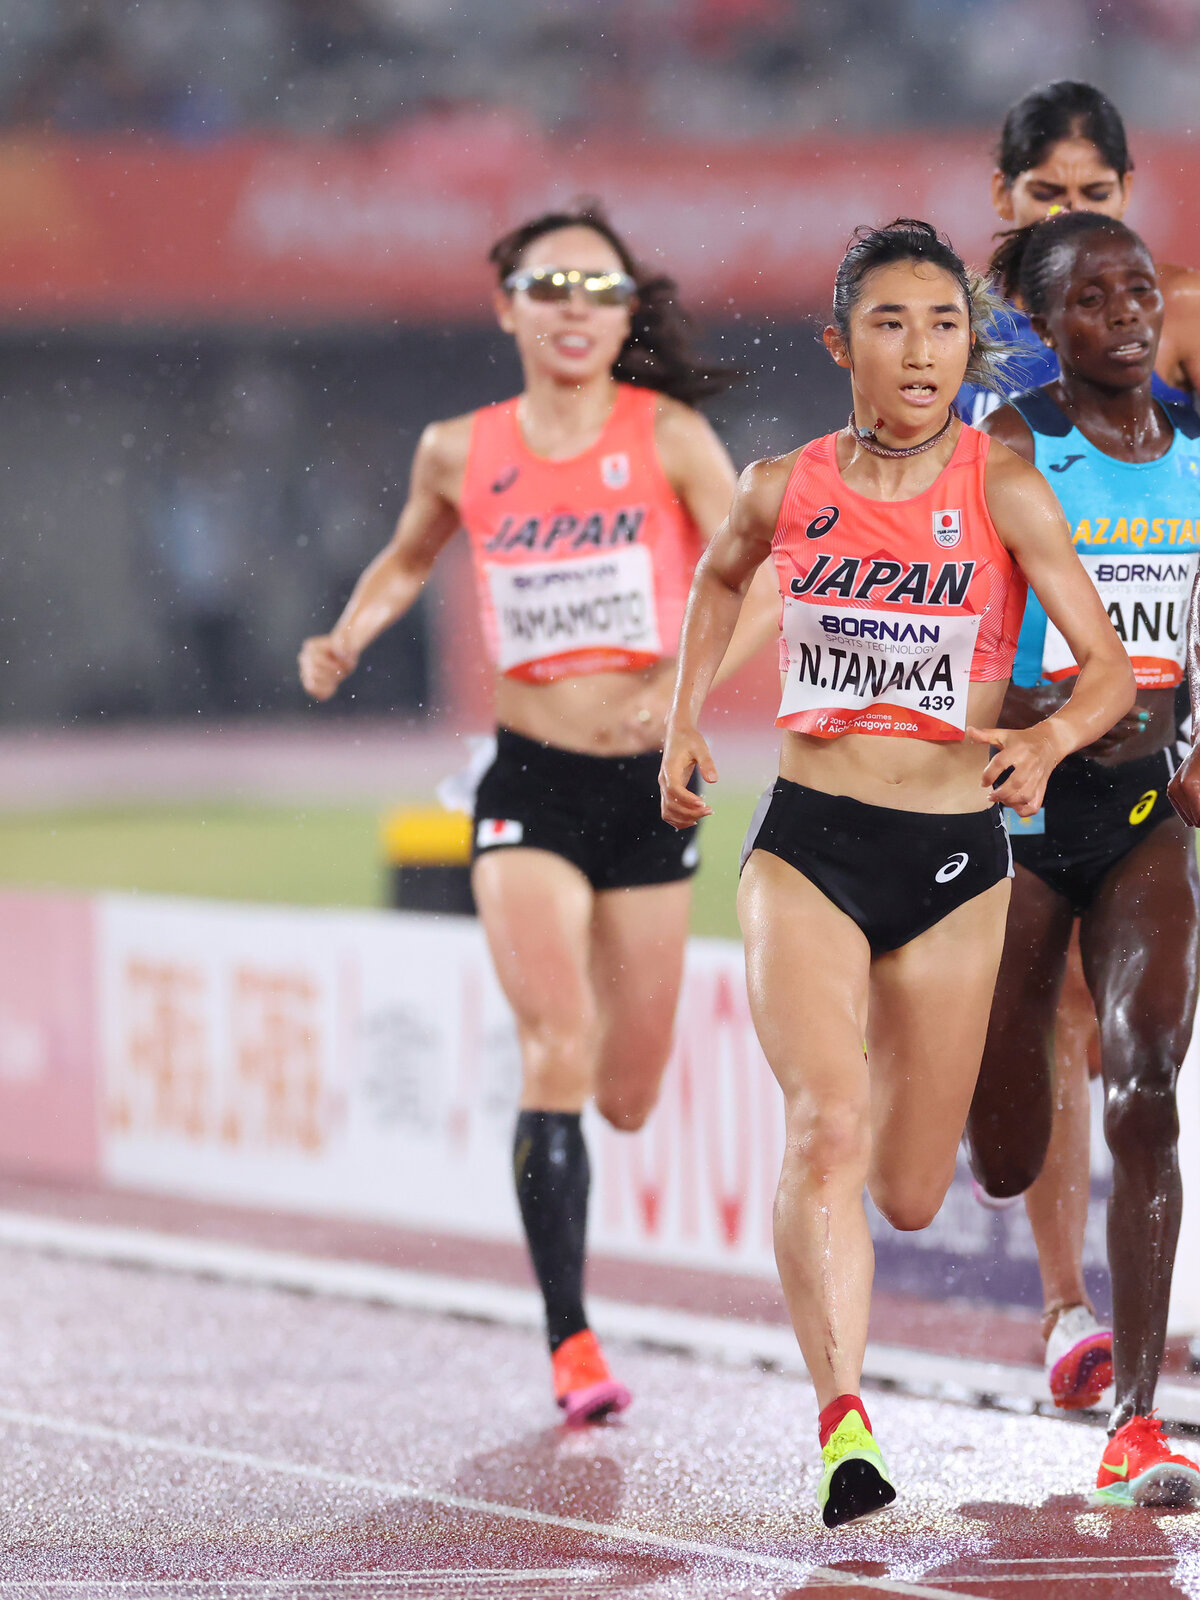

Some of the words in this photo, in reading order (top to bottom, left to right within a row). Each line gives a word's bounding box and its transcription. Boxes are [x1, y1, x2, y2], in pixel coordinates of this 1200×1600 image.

[485, 507, 645, 552] JAPAN
[790, 553, 976, 607] JAPAN
[1095, 564, 1189, 582] BORNAN
[818, 614, 940, 644] BORNAN
[826, 634, 863, 648] SPORTS
[865, 640, 938, 655] TECHNOLOGY
[798, 642, 954, 698] N.TANAKA
[918, 695, 955, 711] 439
[830, 717, 847, 726] 20th
[866, 713, 892, 721] Games
[893, 721, 919, 732] 2026
